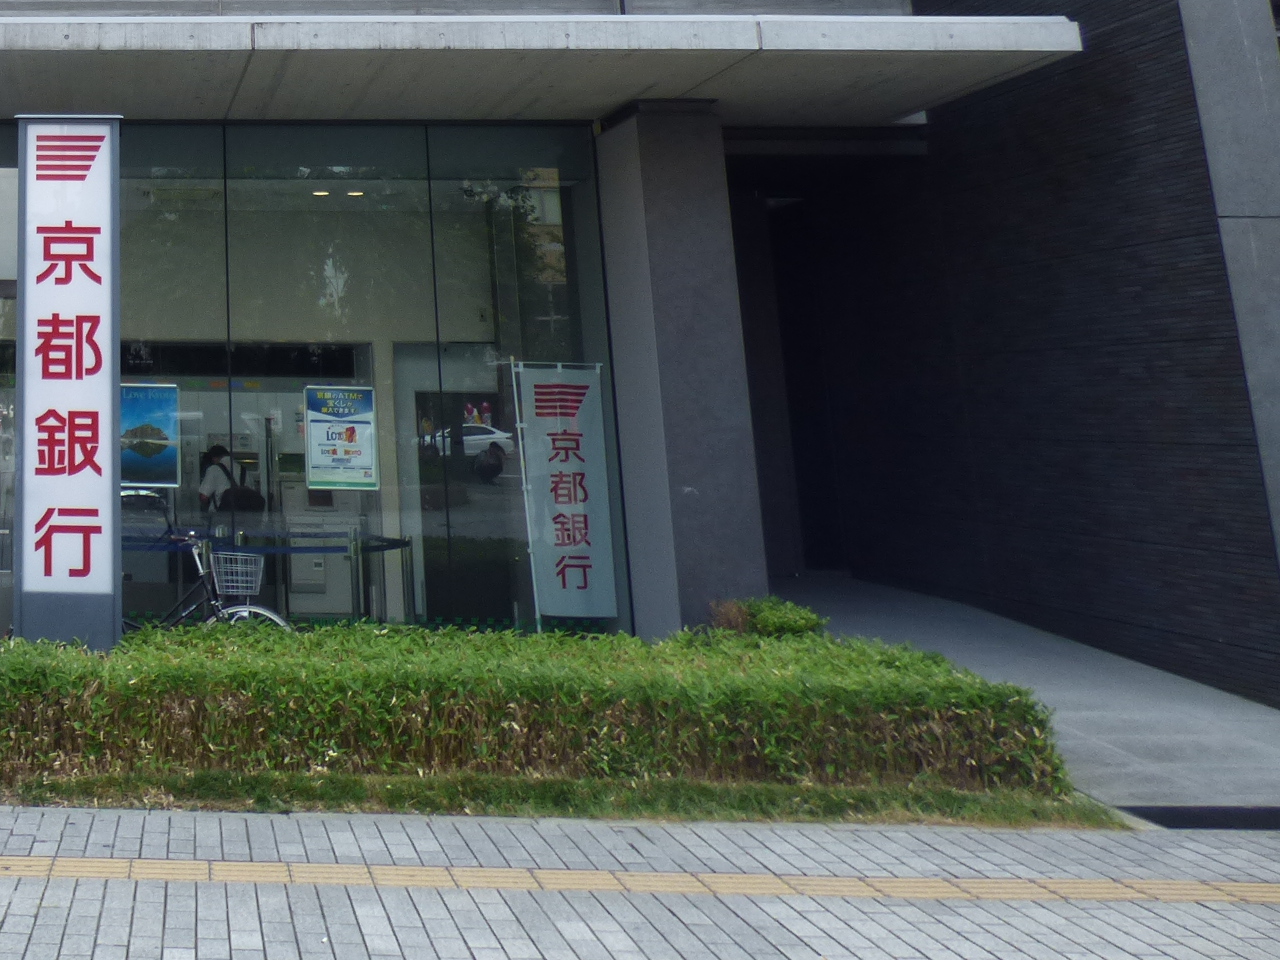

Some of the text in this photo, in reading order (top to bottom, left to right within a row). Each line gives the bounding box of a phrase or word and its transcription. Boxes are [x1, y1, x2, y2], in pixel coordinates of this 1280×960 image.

[34, 220, 103, 578] 京都銀行
[123, 388, 144, 399] Love
[547, 428, 593, 591] 京都銀行
